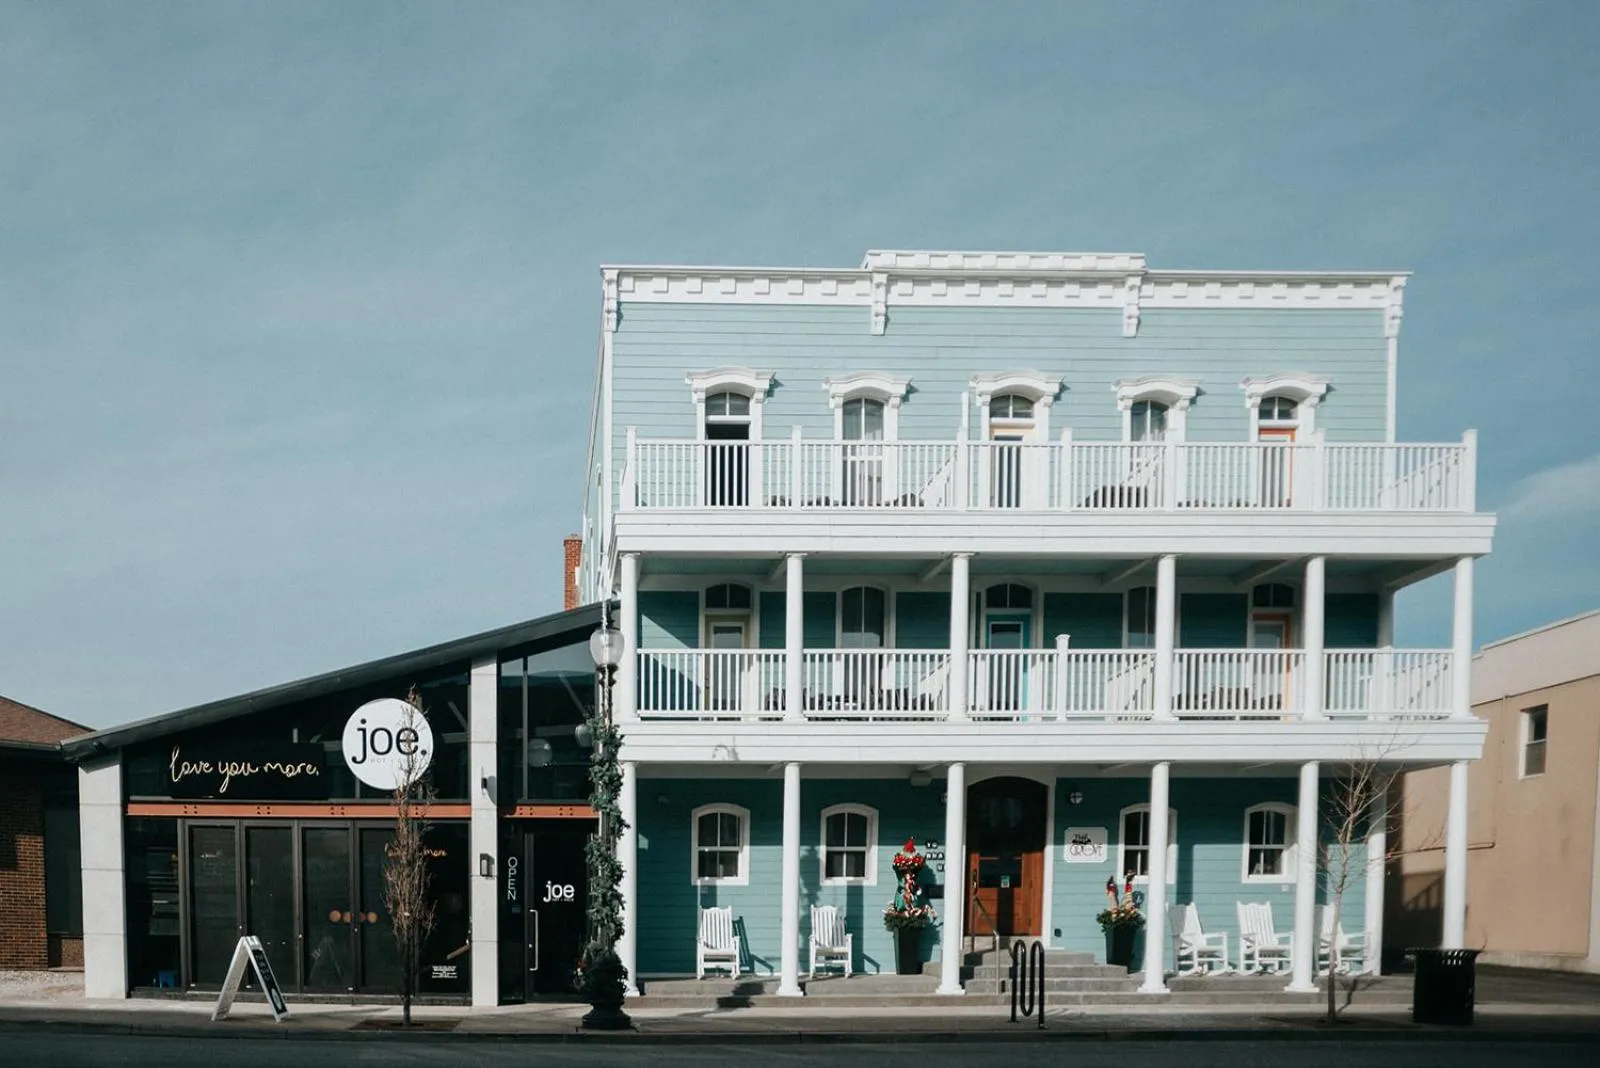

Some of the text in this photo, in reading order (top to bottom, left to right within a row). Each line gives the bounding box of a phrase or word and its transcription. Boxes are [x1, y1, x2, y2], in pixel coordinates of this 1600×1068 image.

[169, 745, 213, 782] love
[218, 761, 259, 793] you
[507, 856, 518, 901] OPEN
[543, 880, 575, 903] joe
